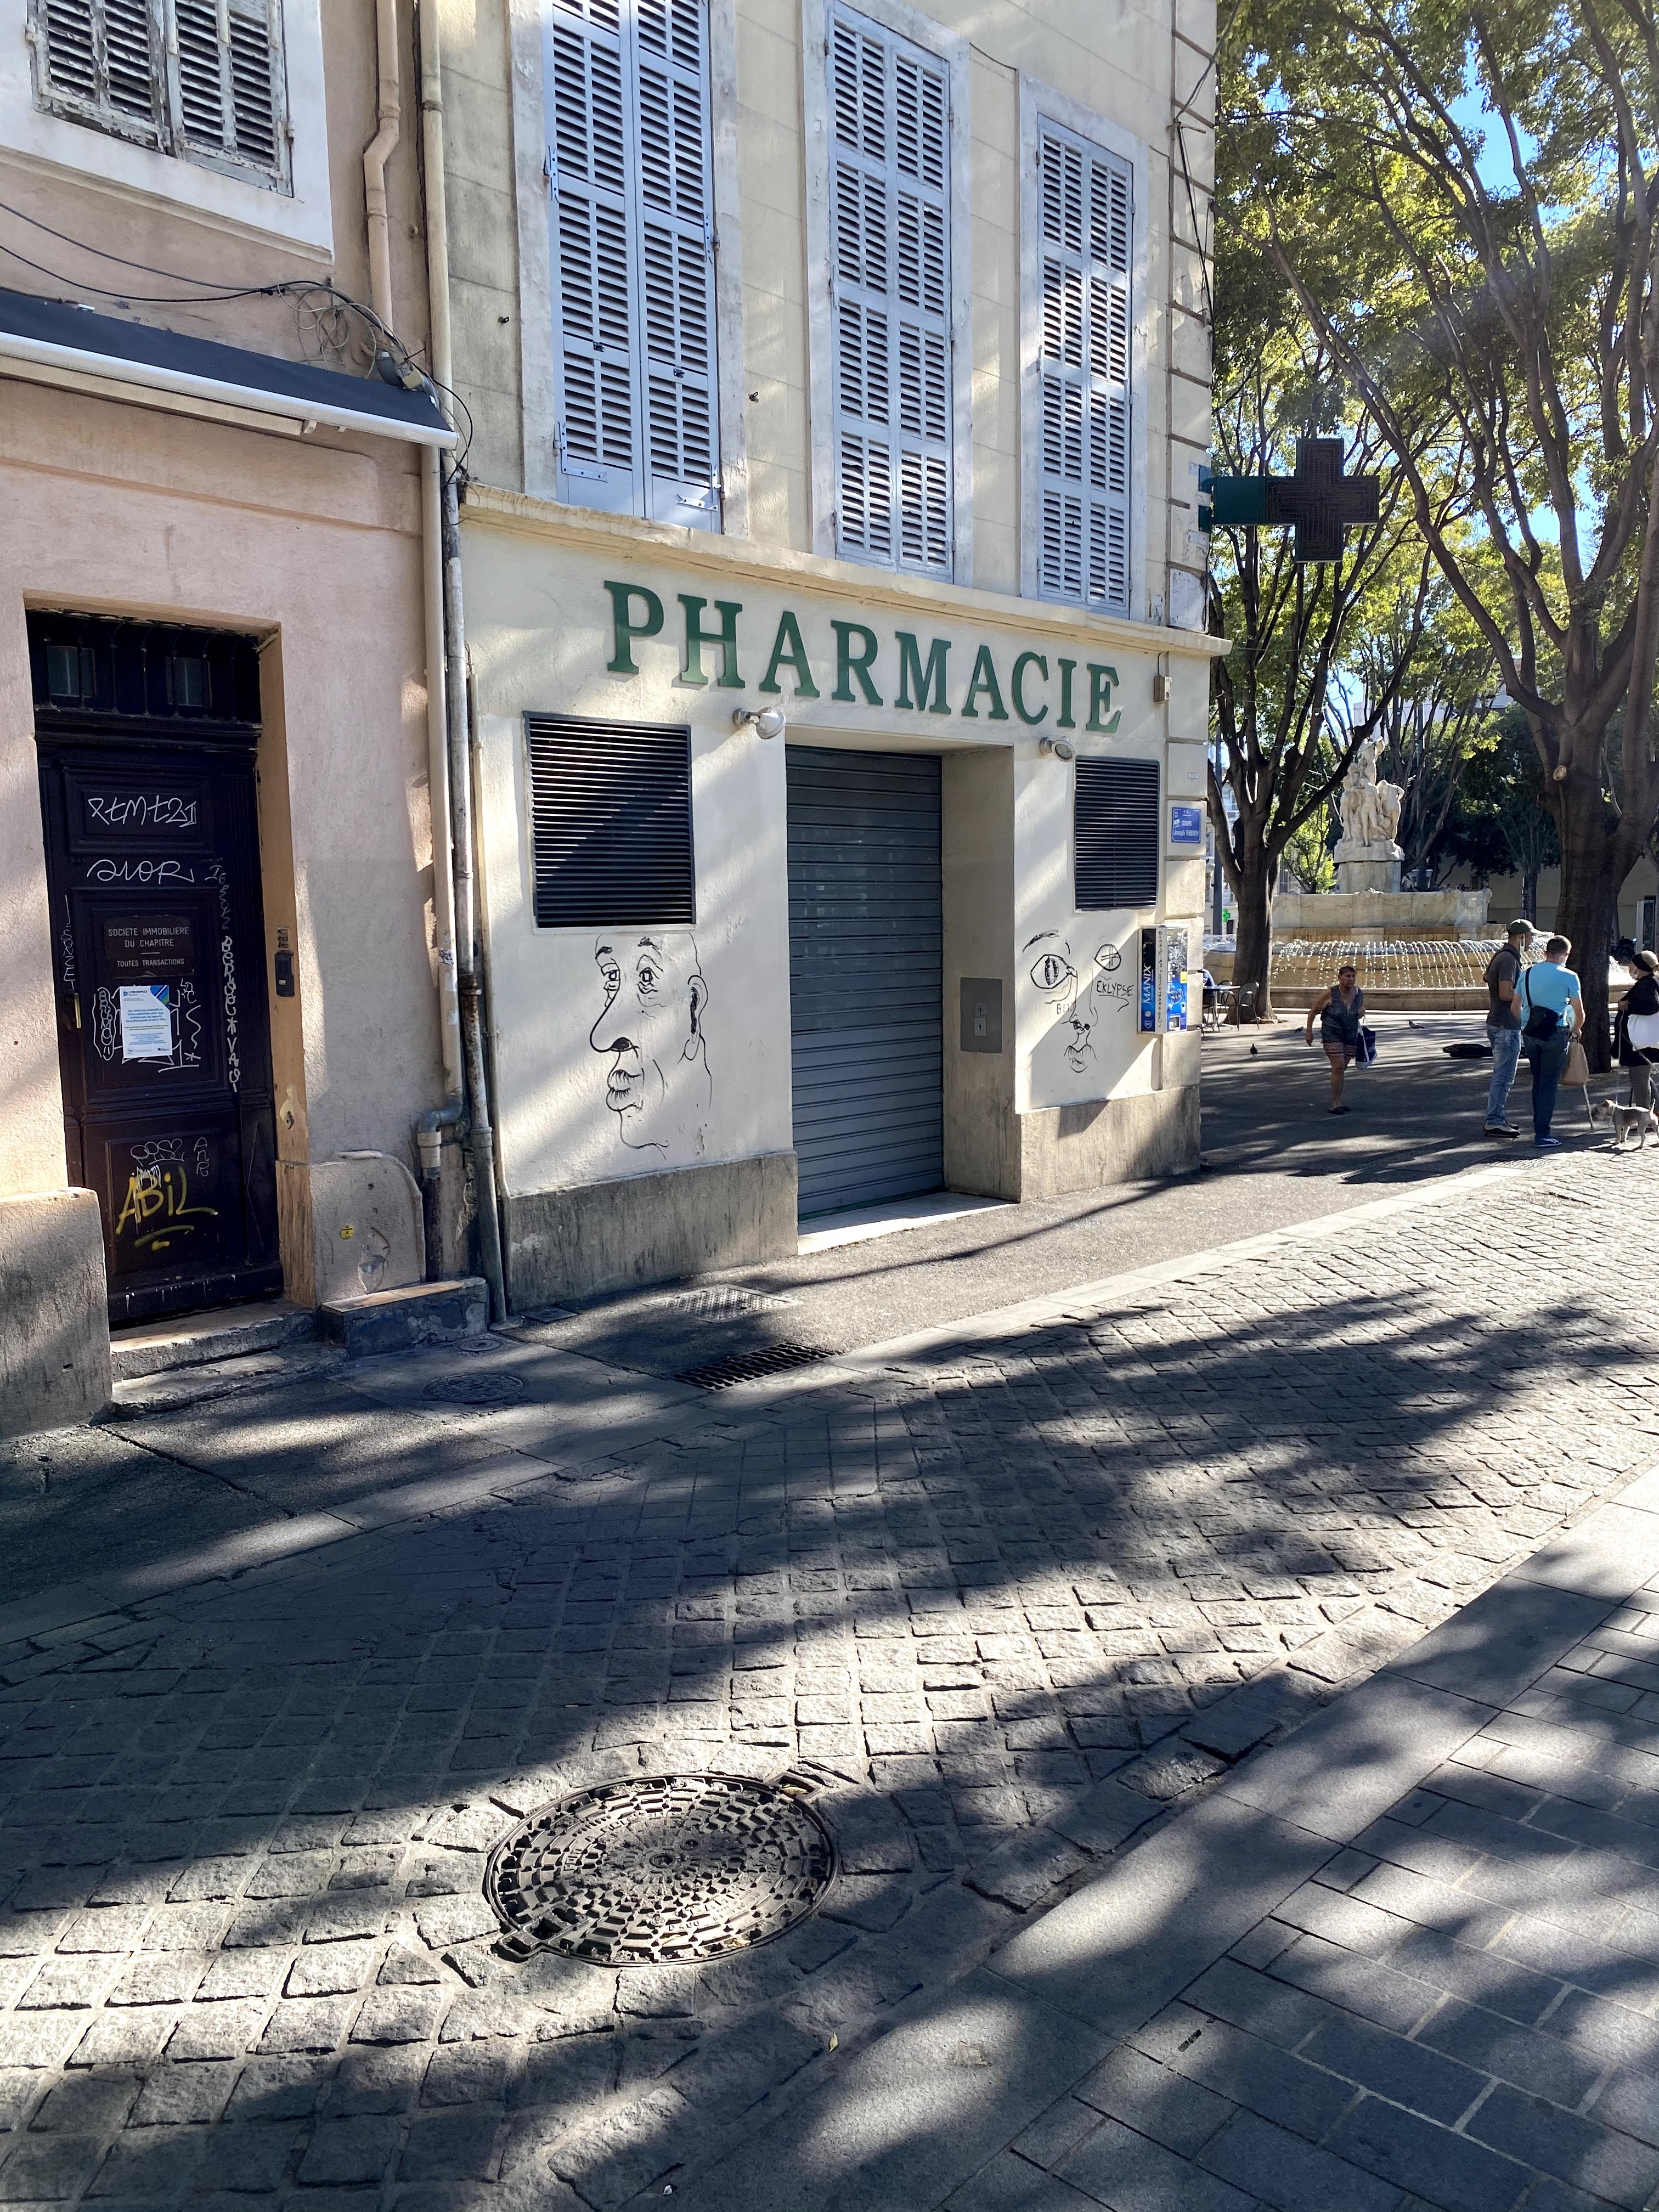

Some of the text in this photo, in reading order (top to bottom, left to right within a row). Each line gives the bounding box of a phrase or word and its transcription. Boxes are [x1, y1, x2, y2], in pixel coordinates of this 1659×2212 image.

[603, 580, 1121, 734] PHARMACIE
[108, 927, 189, 936] SOCIETE IMMOBILIERE
[125, 938, 174, 947] DU CHAPITRE
[142, 958, 184, 966] TRANSACTIONS
[1096, 980, 1135, 997] EKLYPSE
[1143, 964, 1152, 1005] MANIX
